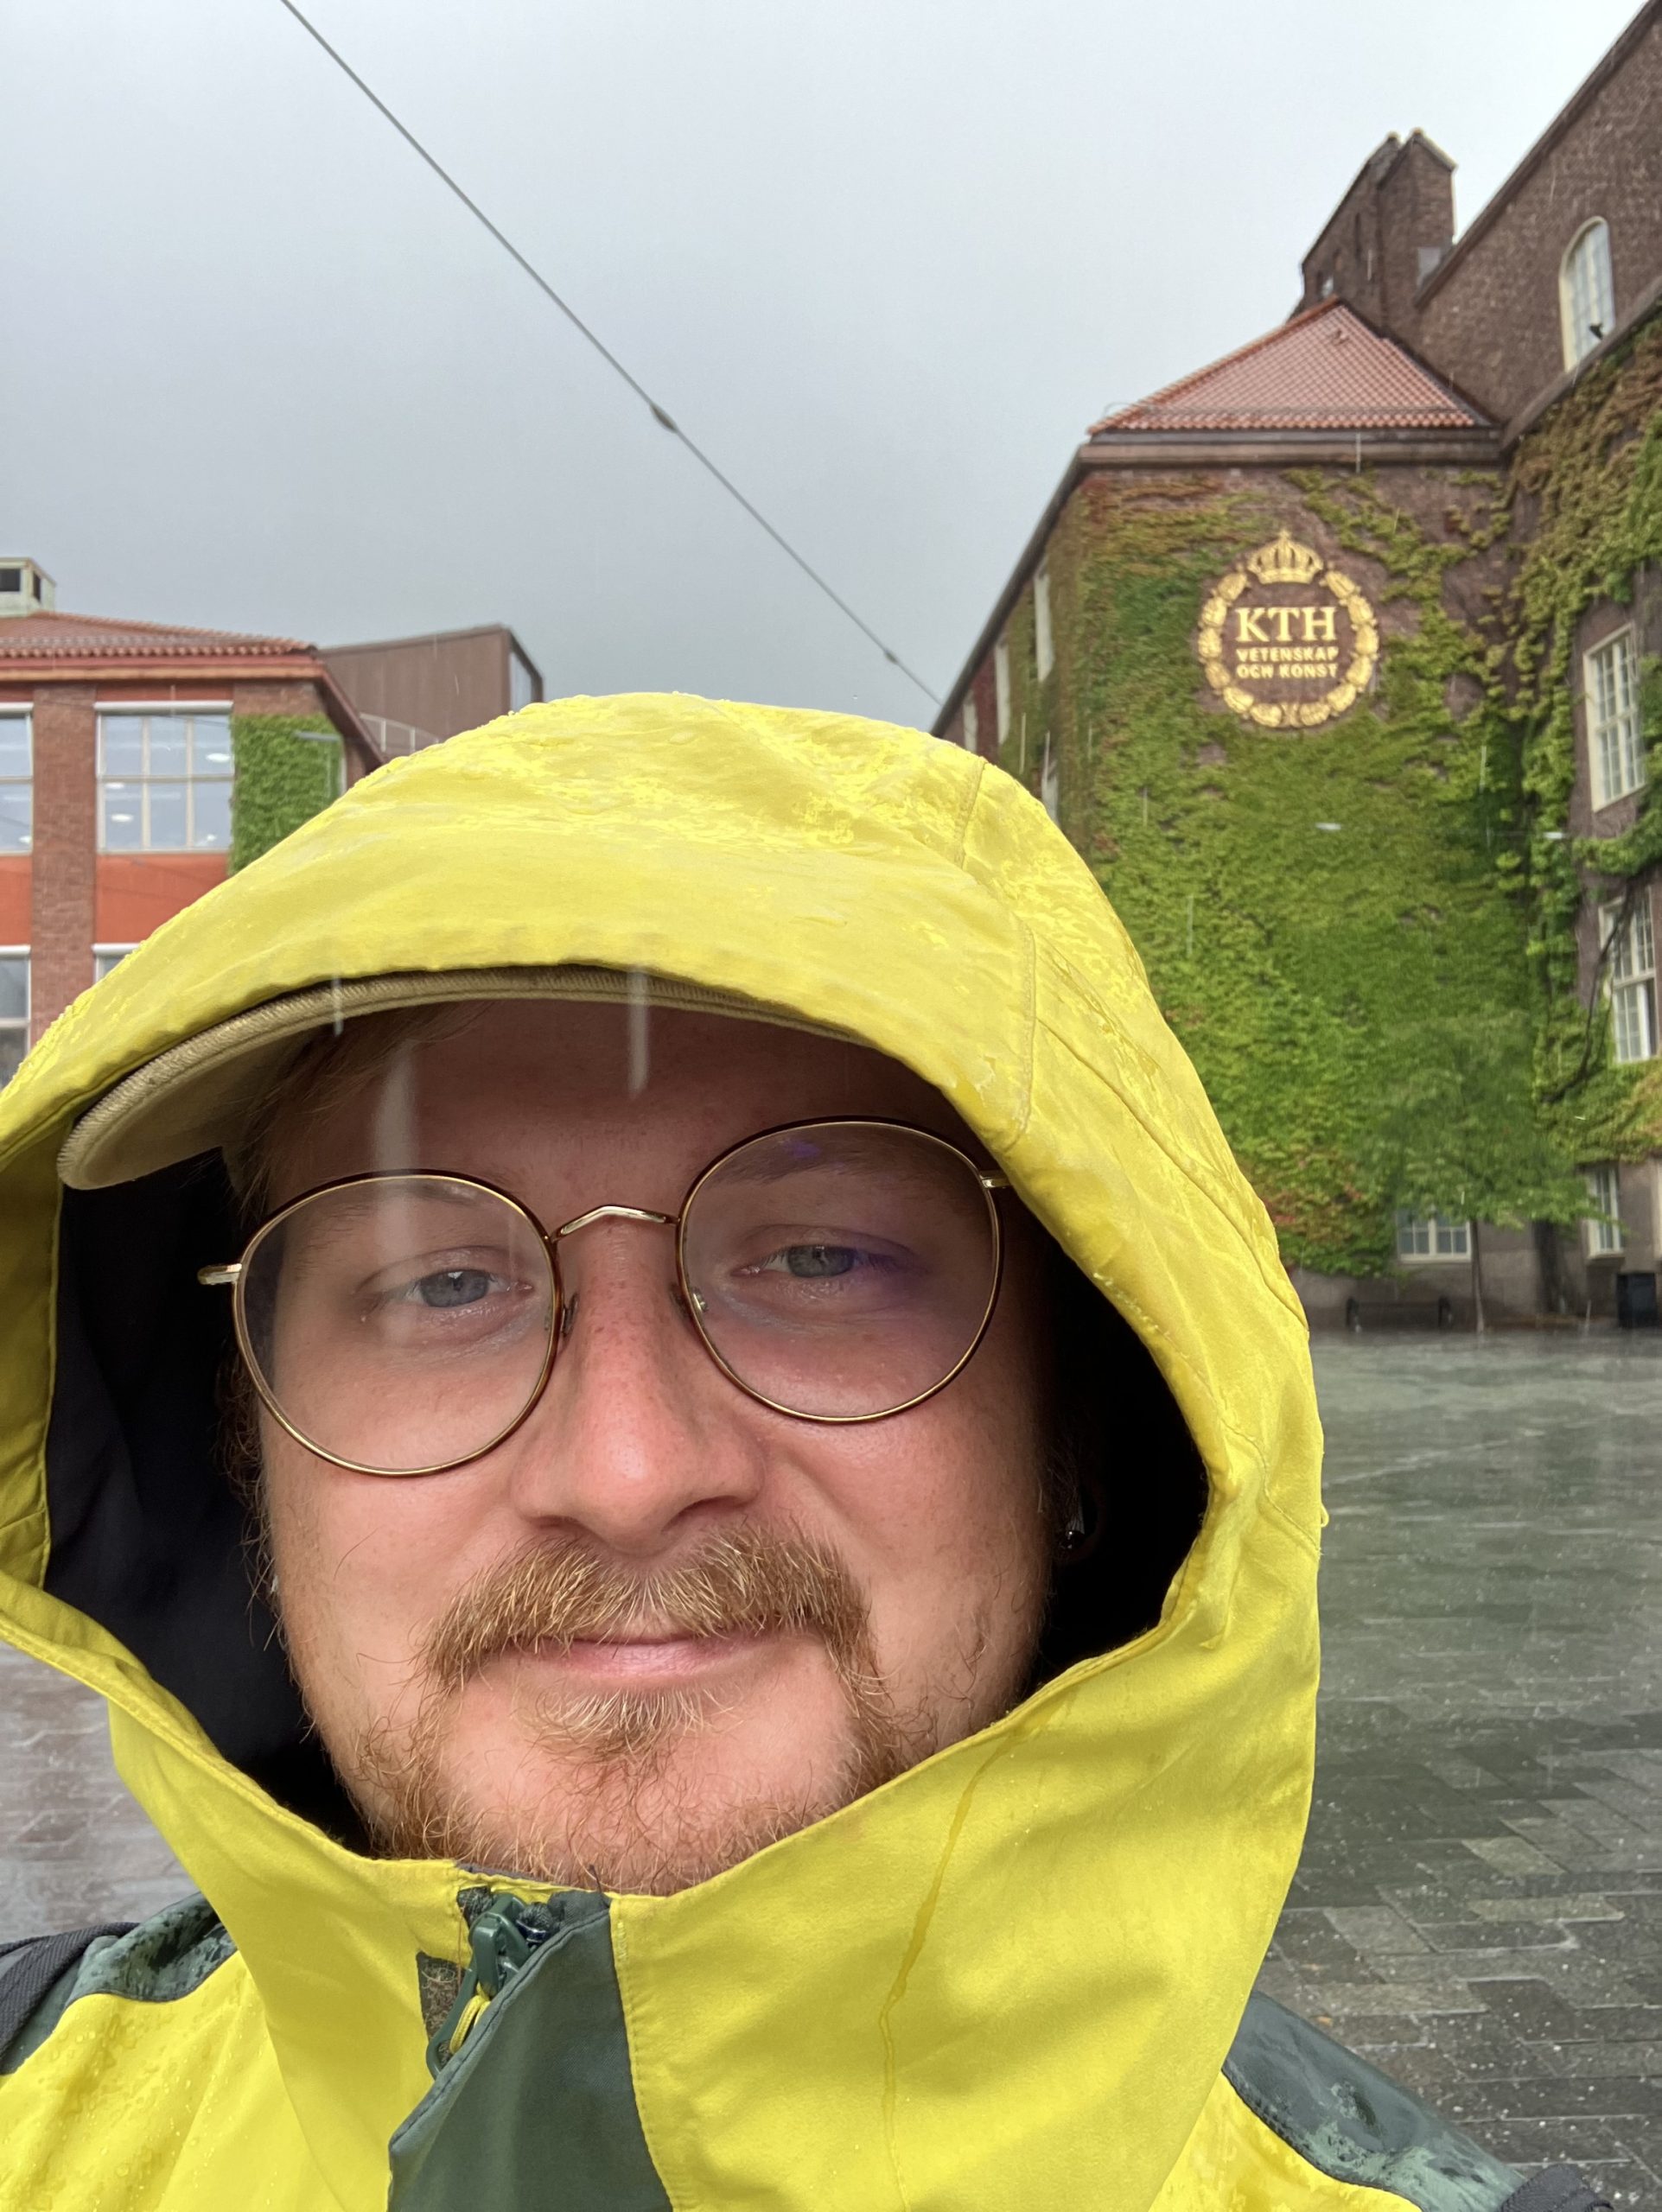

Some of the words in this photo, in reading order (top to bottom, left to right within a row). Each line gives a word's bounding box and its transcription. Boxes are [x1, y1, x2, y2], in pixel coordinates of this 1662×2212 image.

[1235, 607, 1337, 642] KTH
[1236, 646, 1339, 662] VETENSKAP
[1237, 663, 1275, 678] OCH
[1279, 663, 1339, 678] KONST
